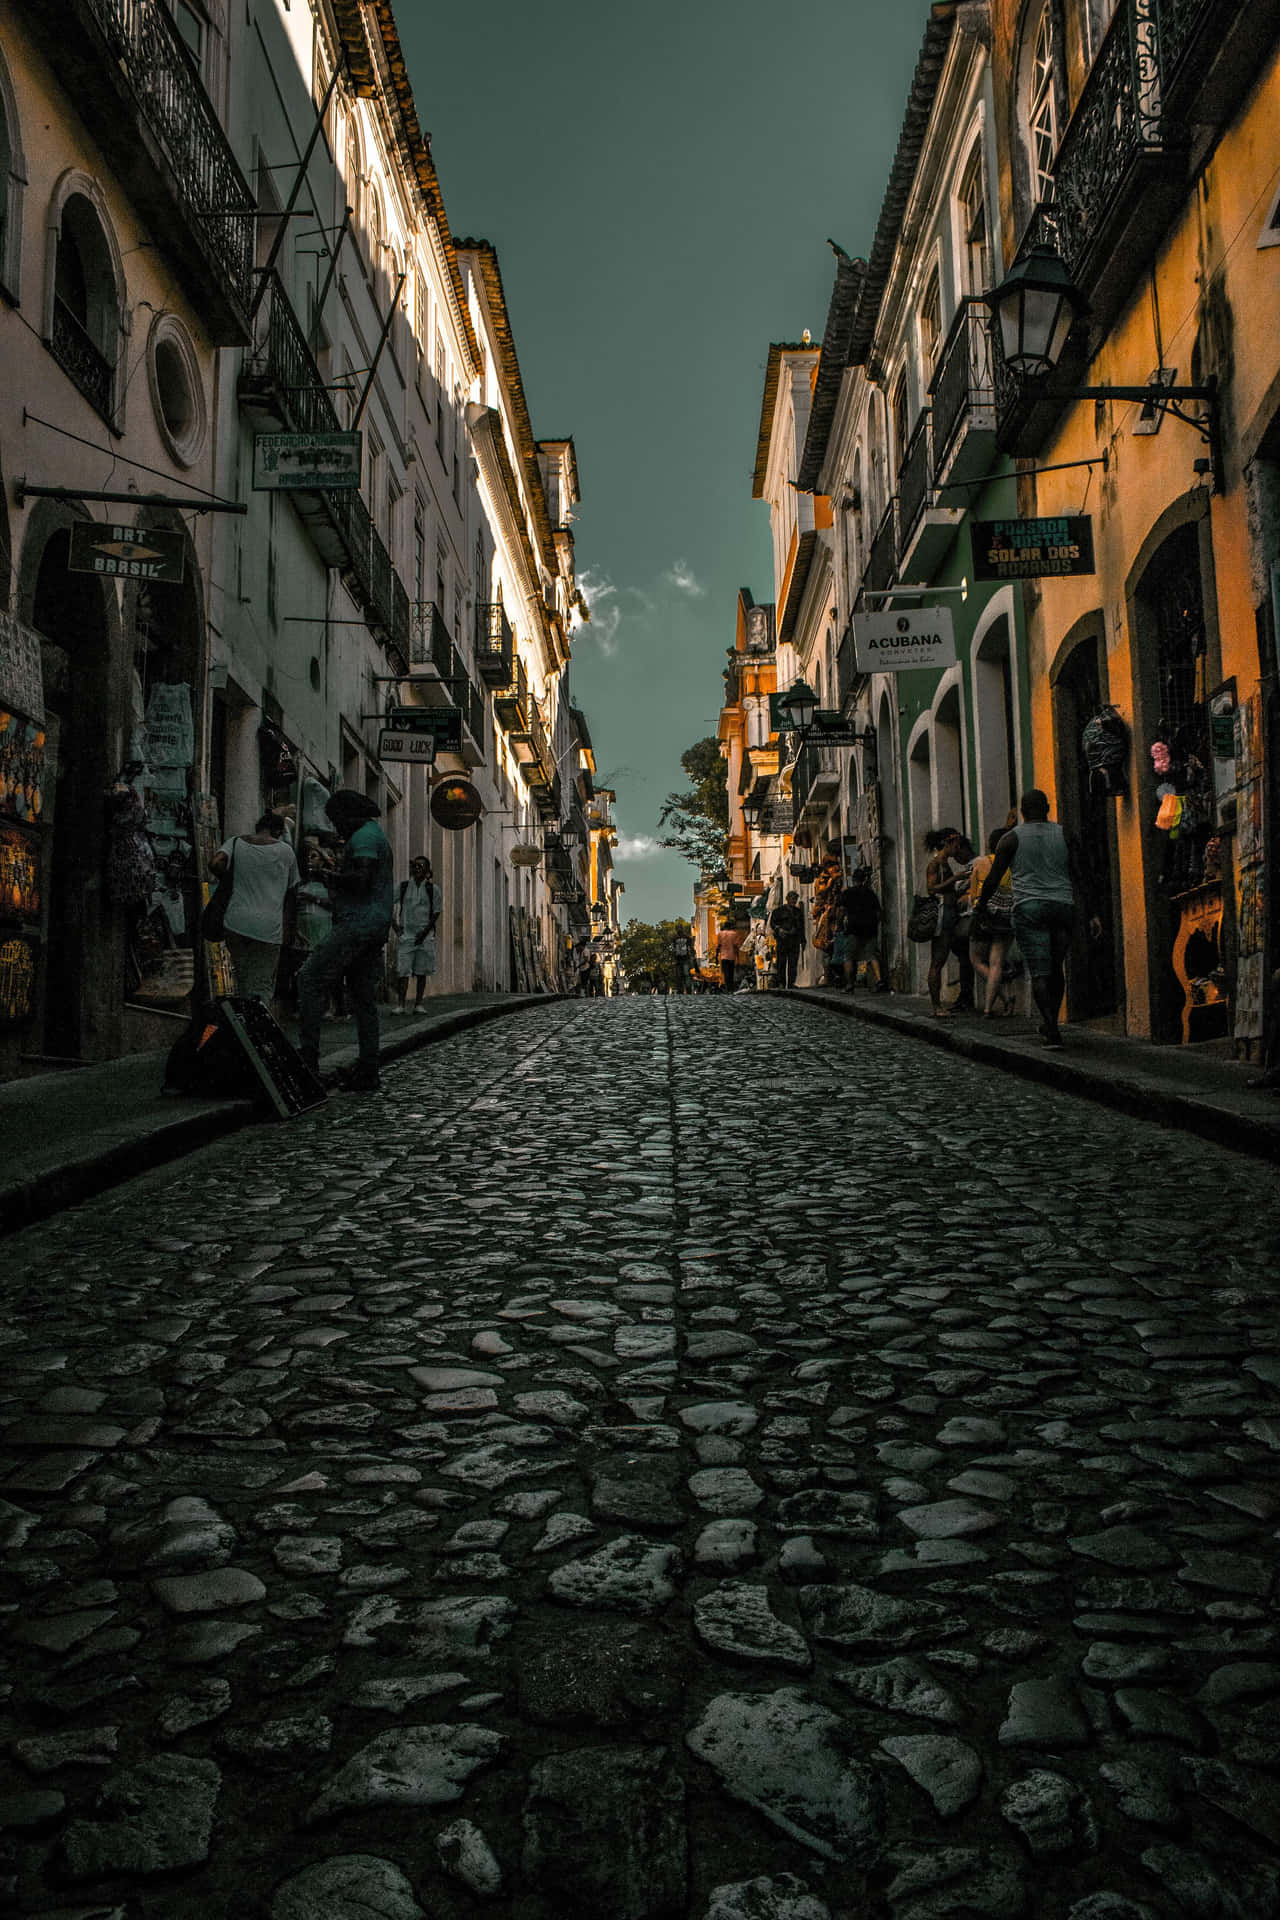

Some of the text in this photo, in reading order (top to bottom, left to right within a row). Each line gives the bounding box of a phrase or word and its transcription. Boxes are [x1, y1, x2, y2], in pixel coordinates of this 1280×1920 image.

[113, 527, 147, 543] ART
[994, 519, 1069, 536] POUSADA
[1011, 533, 1074, 548] HOSTEL
[987, 545, 1080, 564] SOLAR DOS
[95, 558, 159, 577] BRASIL
[997, 559, 1072, 577] ROMANOS
[868, 634, 943, 650] ACUBANA
[383, 739, 403, 753] GOOD
[410, 740, 431, 754] LUCK
